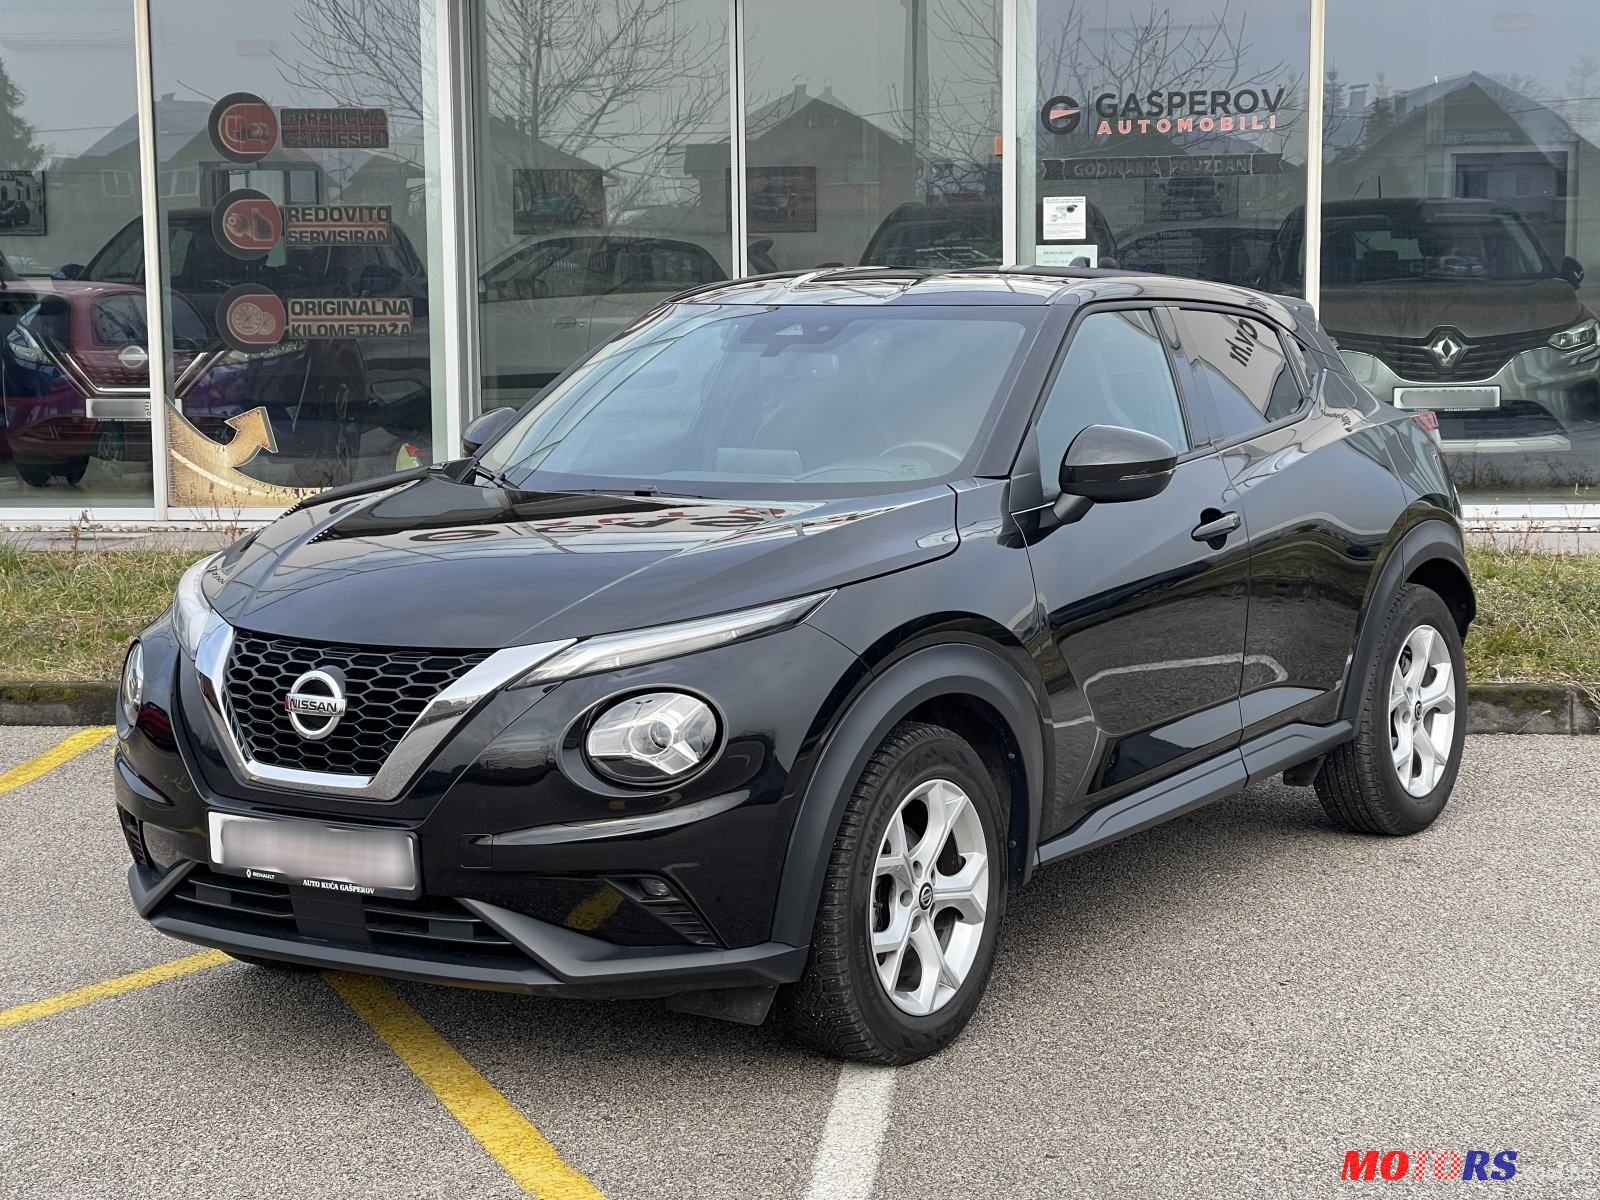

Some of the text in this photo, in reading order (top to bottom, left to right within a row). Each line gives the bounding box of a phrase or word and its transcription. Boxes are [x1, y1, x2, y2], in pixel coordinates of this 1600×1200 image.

[1095, 87, 1285, 118] GASPEROV
[1097, 115, 1277, 135] AUTOMOBILI
[287, 206, 390, 223] REDOVITO
[288, 229, 390, 244] SERVISIRAN
[290, 300, 411, 316] ORIGINALNA
[290, 322, 411, 338] KILOMETRAŽA
[289, 700, 337, 713] NISSAN
[252, 871, 275, 880] RENAULT
[302, 879, 375, 895] AUTO KUĆA GAŠPEROV
